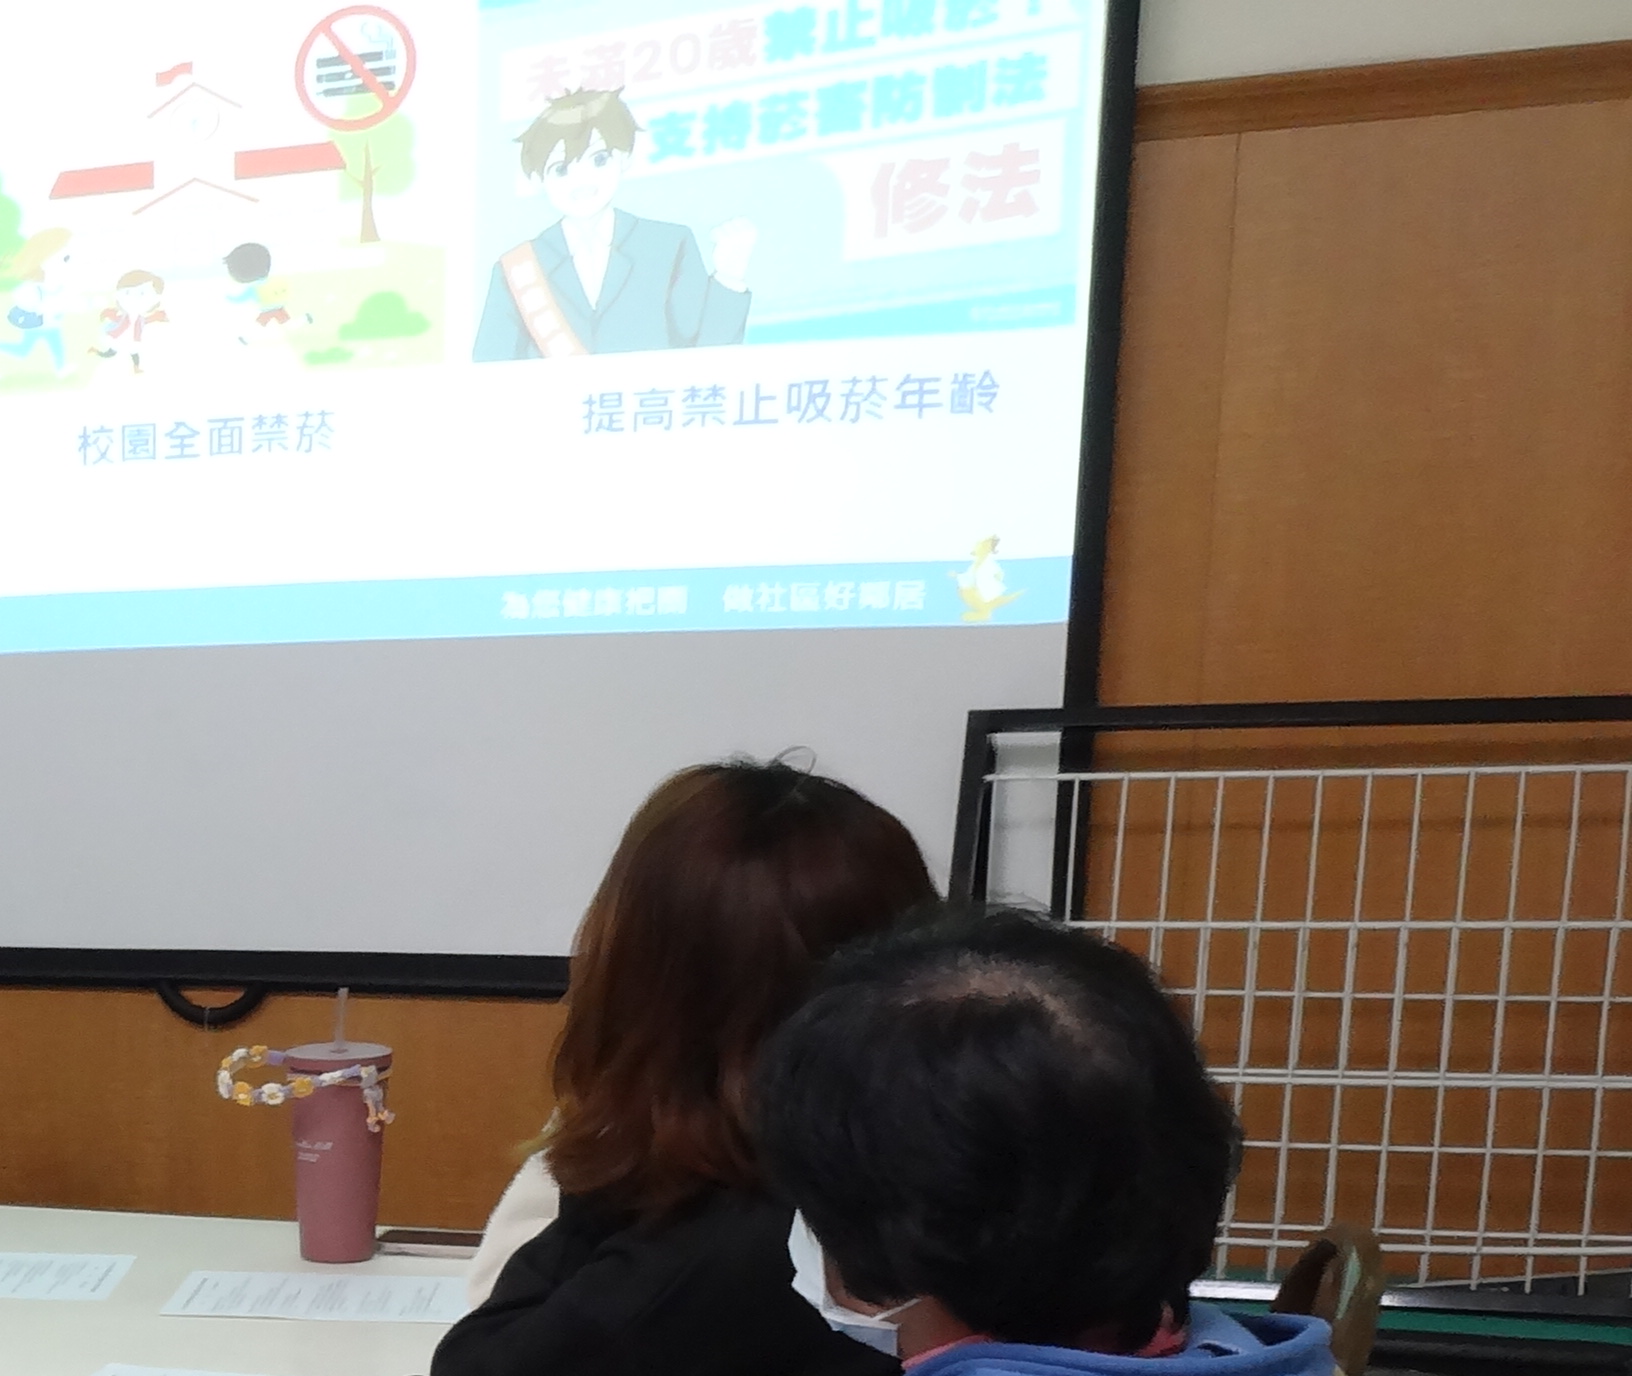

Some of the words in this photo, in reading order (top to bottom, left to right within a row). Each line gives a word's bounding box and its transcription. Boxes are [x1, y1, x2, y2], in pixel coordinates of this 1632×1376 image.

[648, 52, 1050, 163] 支持菸害防制法
[870, 142, 1043, 240] 修法
[78, 410, 334, 465] 校園全面禁菸
[581, 369, 1000, 434] 提高禁止吸菸年齡
